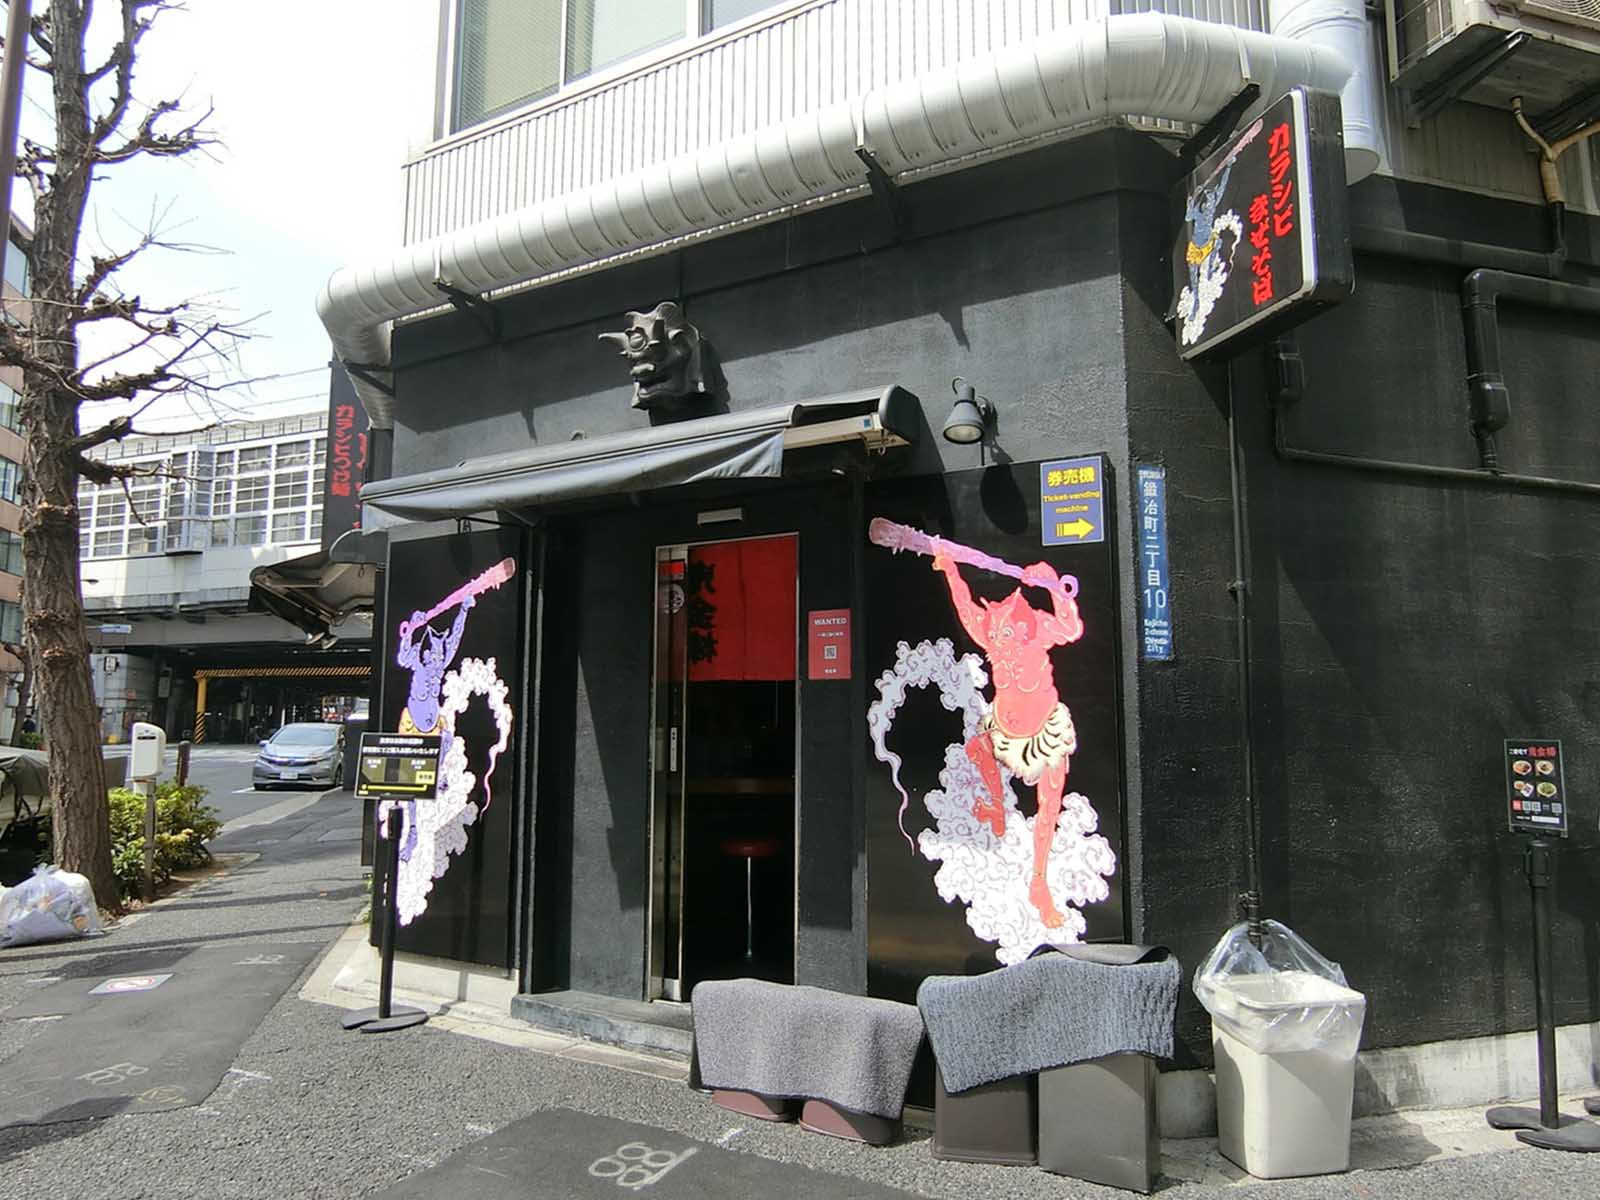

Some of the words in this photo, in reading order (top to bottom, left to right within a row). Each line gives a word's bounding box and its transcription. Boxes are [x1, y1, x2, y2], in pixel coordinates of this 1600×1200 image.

[1268, 122, 1294, 238] カラシビ
[1249, 194, 1274, 306] まぜそば
[1047, 466, 1096, 487] 券売機
[1055, 504, 1089, 513] machine
[1143, 589, 1167, 609] 10
[814, 617, 847, 626] WANTED
